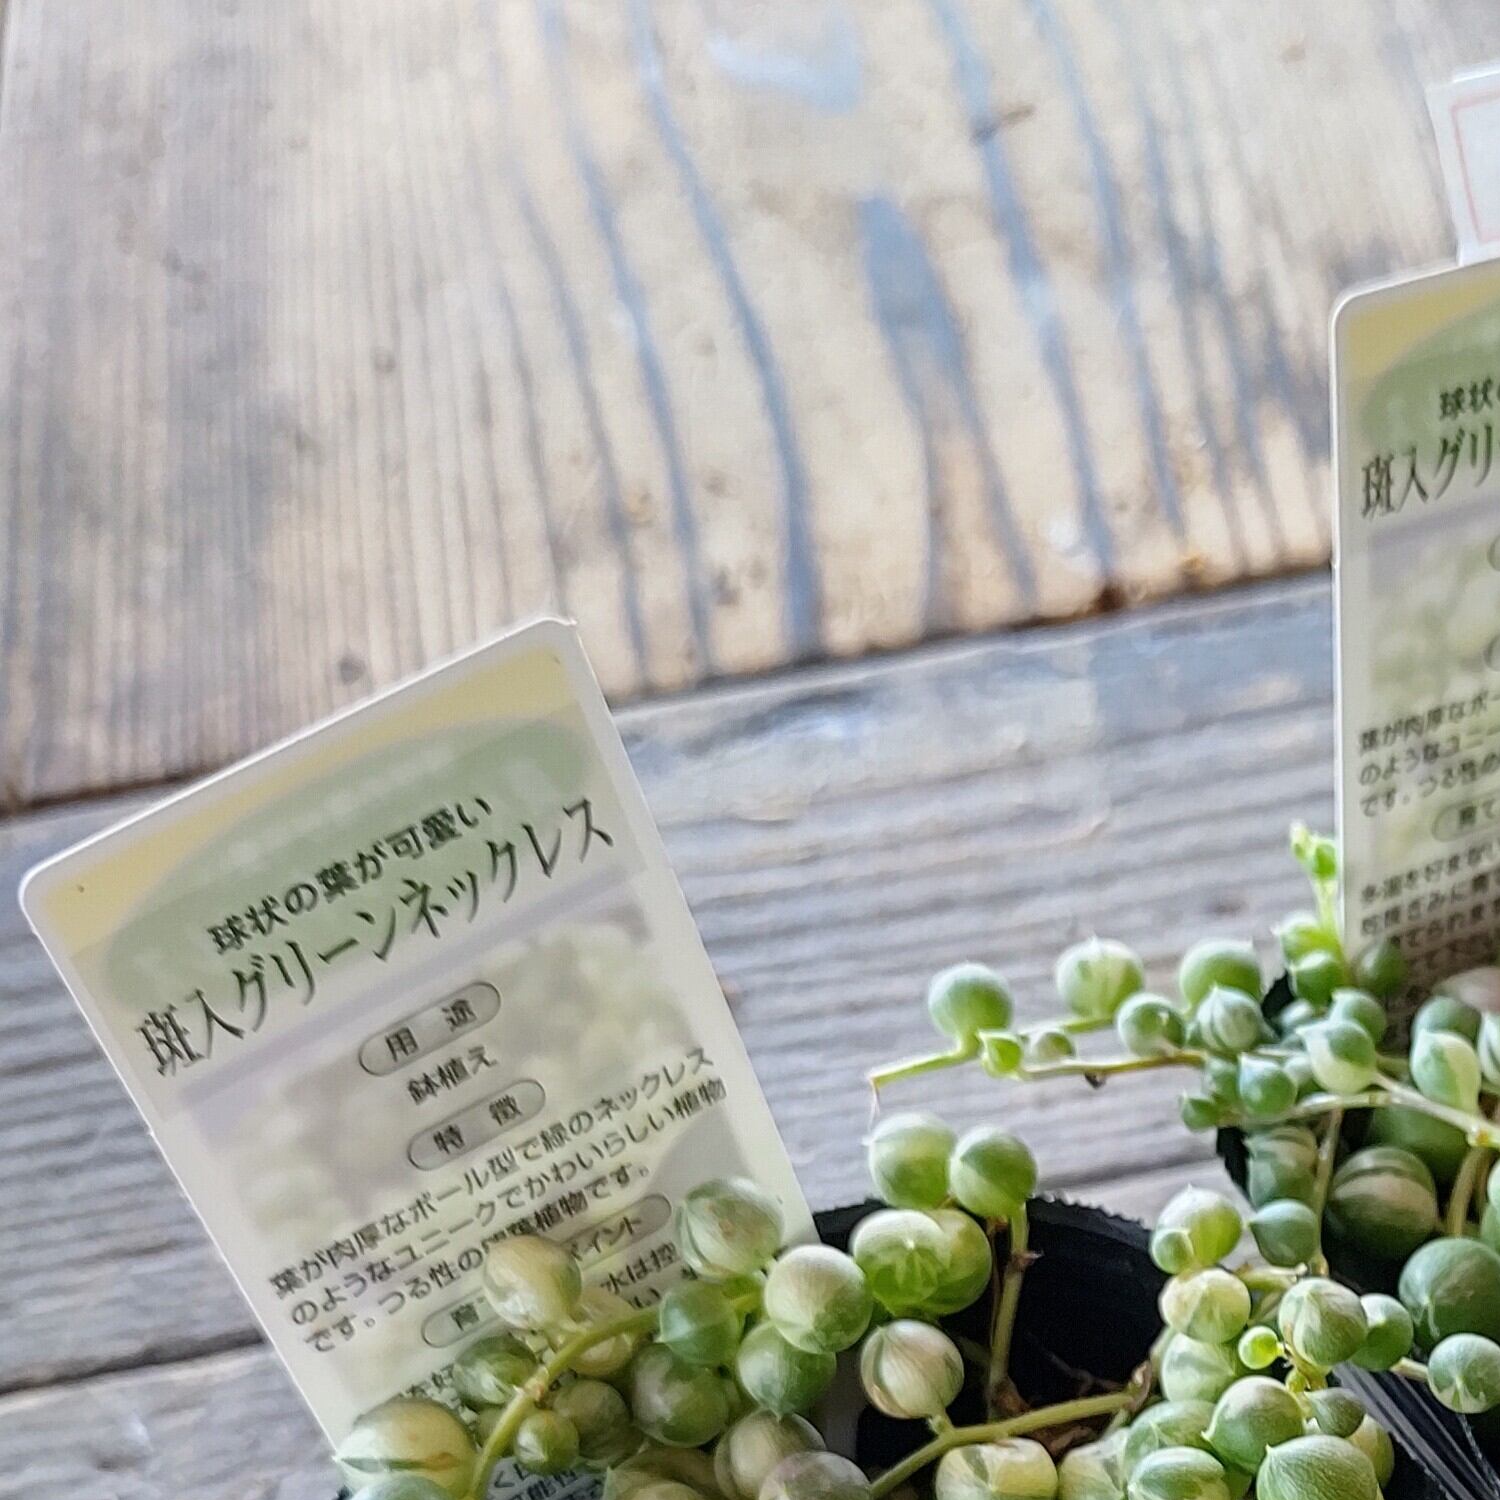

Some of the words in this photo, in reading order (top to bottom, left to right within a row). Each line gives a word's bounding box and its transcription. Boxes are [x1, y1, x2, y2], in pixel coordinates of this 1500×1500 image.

[136, 797, 613, 1077] 斑入グリーンネックレス
[207, 797, 492, 955] 球状の葉が可愛い
[269, 1046, 714, 1299] 葉が肉厚なボール型で緑のネックレス
[407, 1045, 497, 1105] 鉢植え
[291, 1077, 727, 1325] のようなユニークでかわいらしい植物
